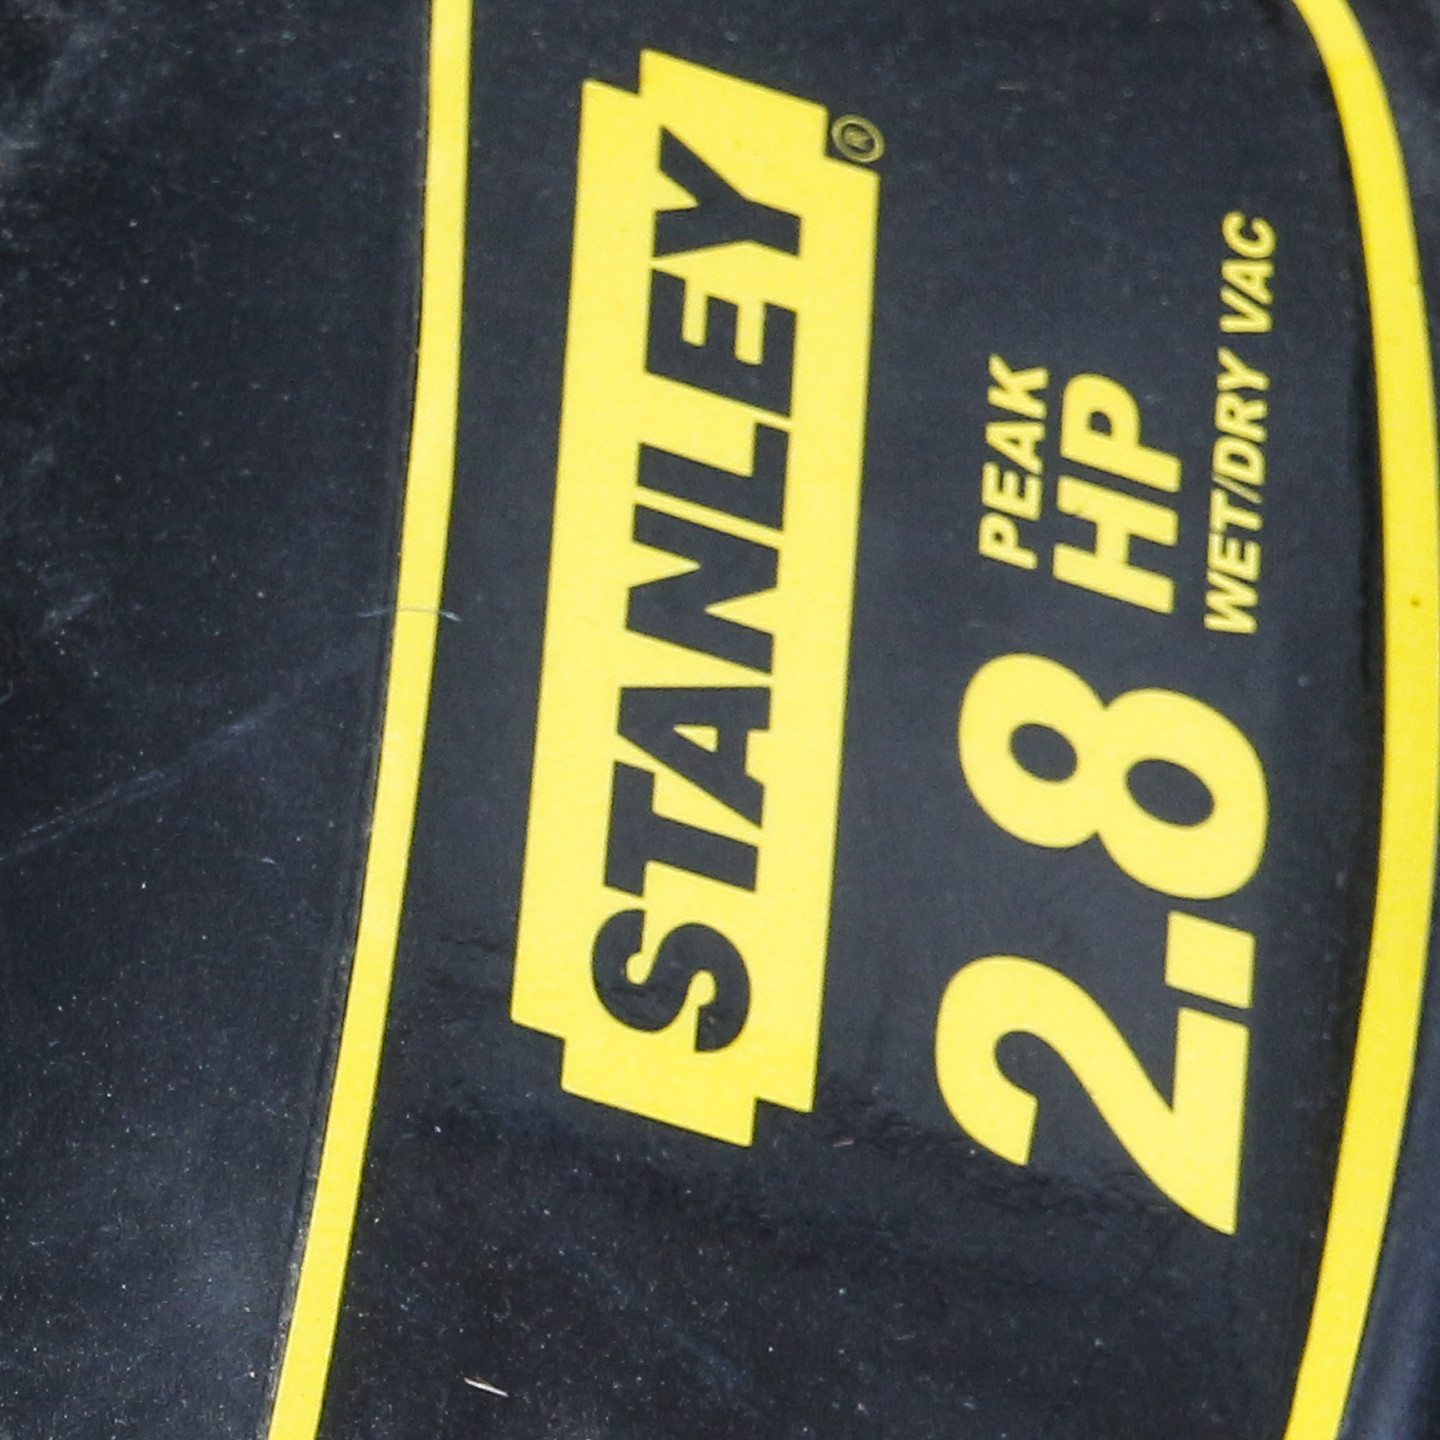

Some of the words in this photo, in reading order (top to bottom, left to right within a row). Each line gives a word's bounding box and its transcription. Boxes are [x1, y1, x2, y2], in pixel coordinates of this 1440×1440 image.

[1220, 213, 1275, 332] VAC
[587, 126, 803, 1054] STANLEY
[979, 357, 1048, 568] PEAK
[1053, 374, 1181, 613] HP
[1205, 350, 1268, 633] WET/DRY
[935, 654, 1268, 1234] 2.8
